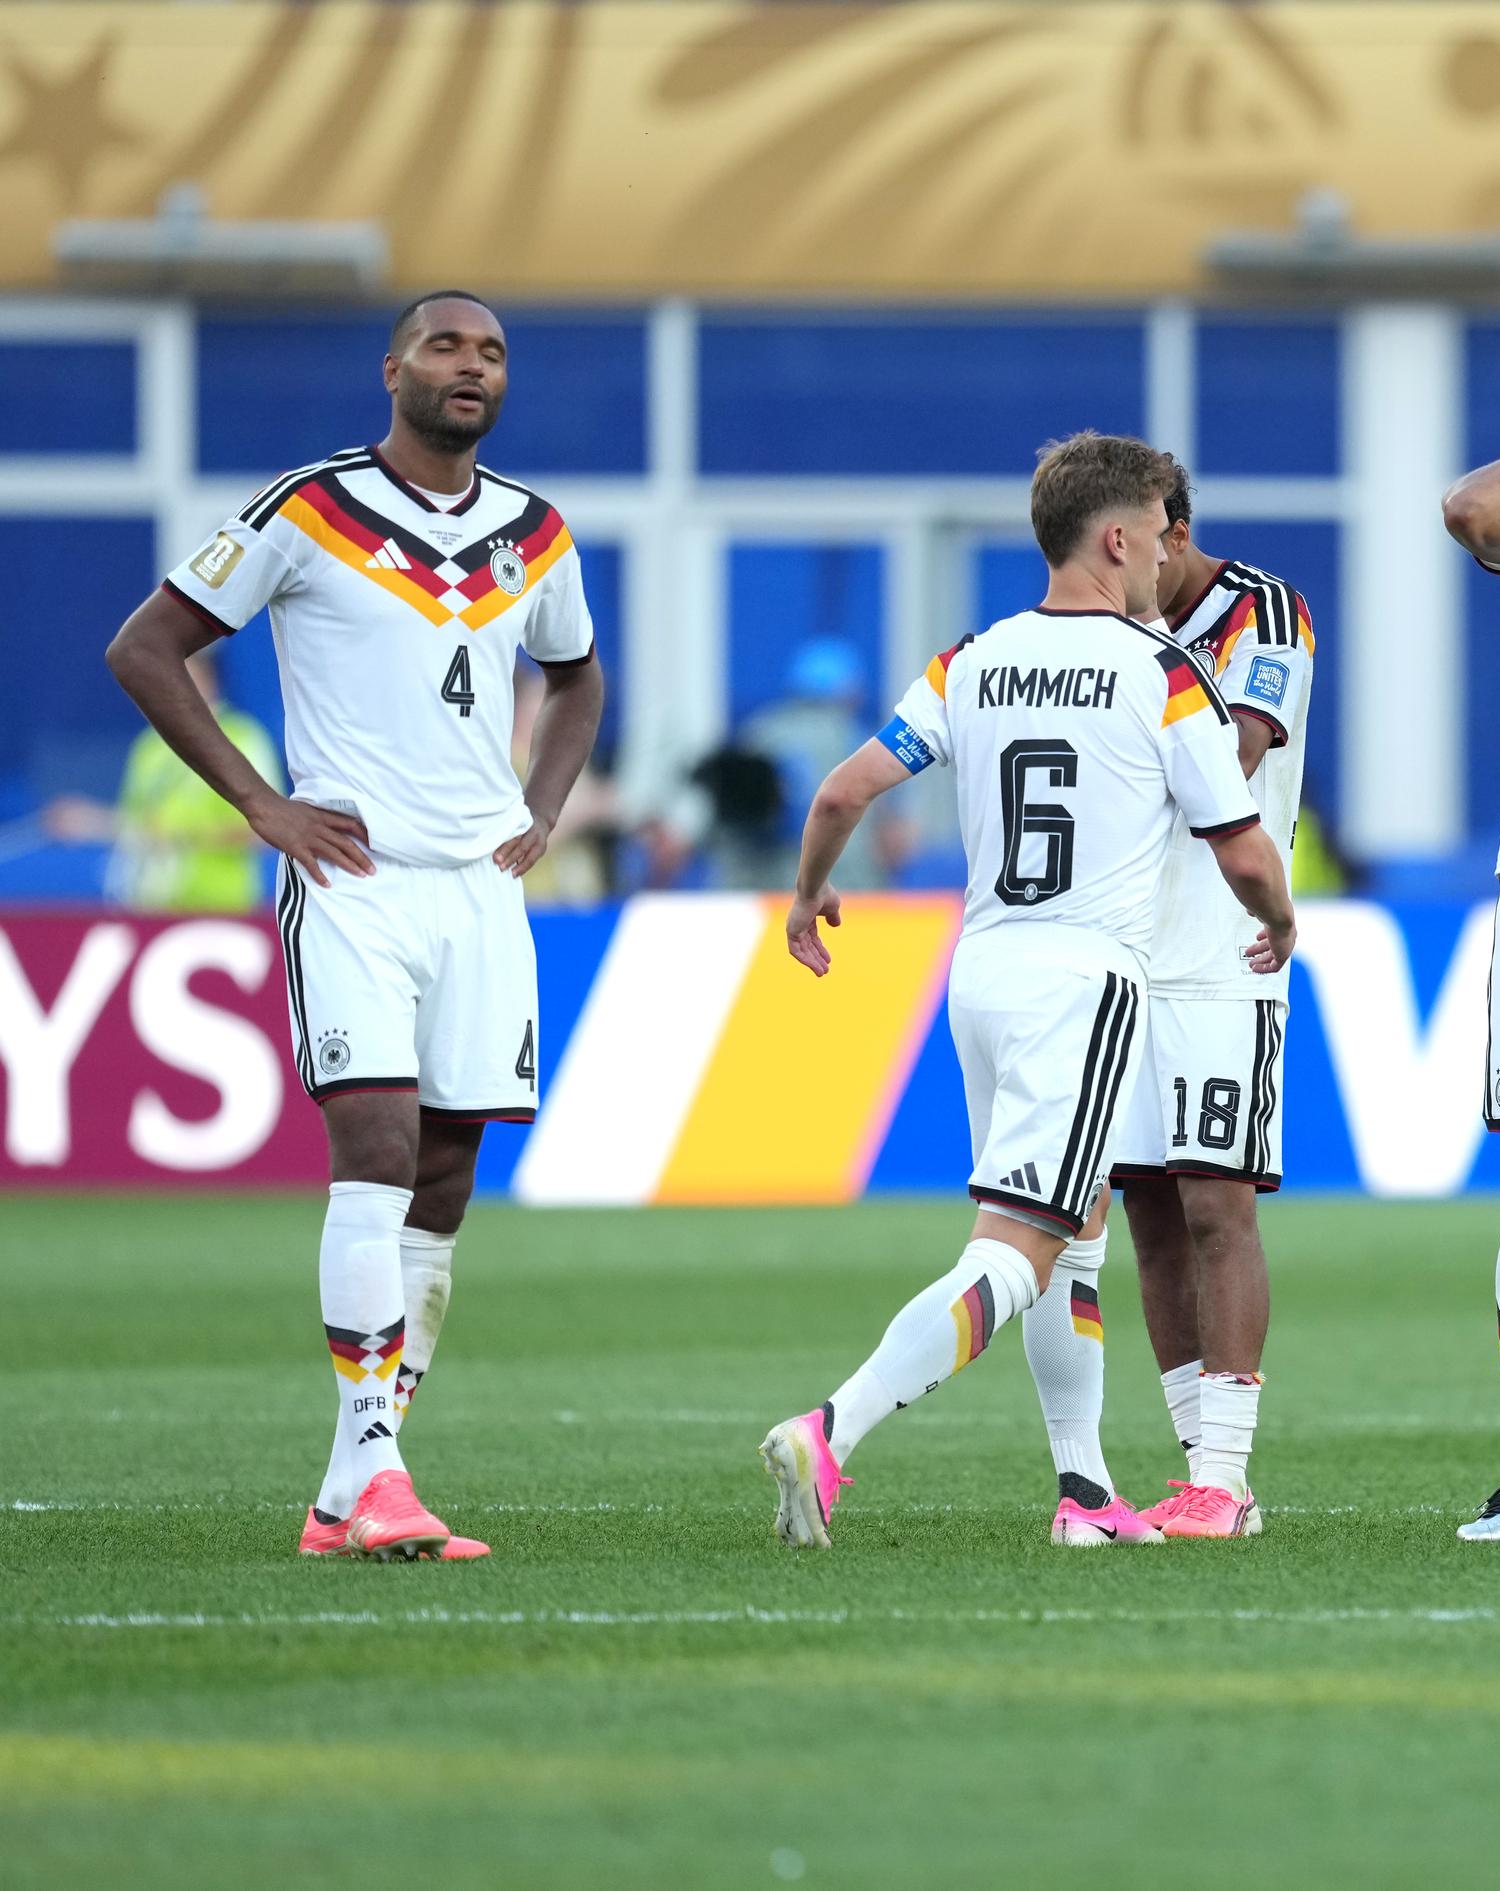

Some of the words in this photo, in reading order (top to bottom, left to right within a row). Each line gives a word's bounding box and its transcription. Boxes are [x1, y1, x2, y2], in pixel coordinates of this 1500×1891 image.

[441, 645, 474, 717] 4
[979, 667, 1117, 709] KIMMICH
[1256, 672, 1283, 688] UNITES
[895, 730, 909, 745] the
[994, 739, 1078, 906] 6
[515, 1019, 535, 1092] 4
[1173, 1077, 1240, 1150] 18
[354, 1396, 386, 1414] DFB
